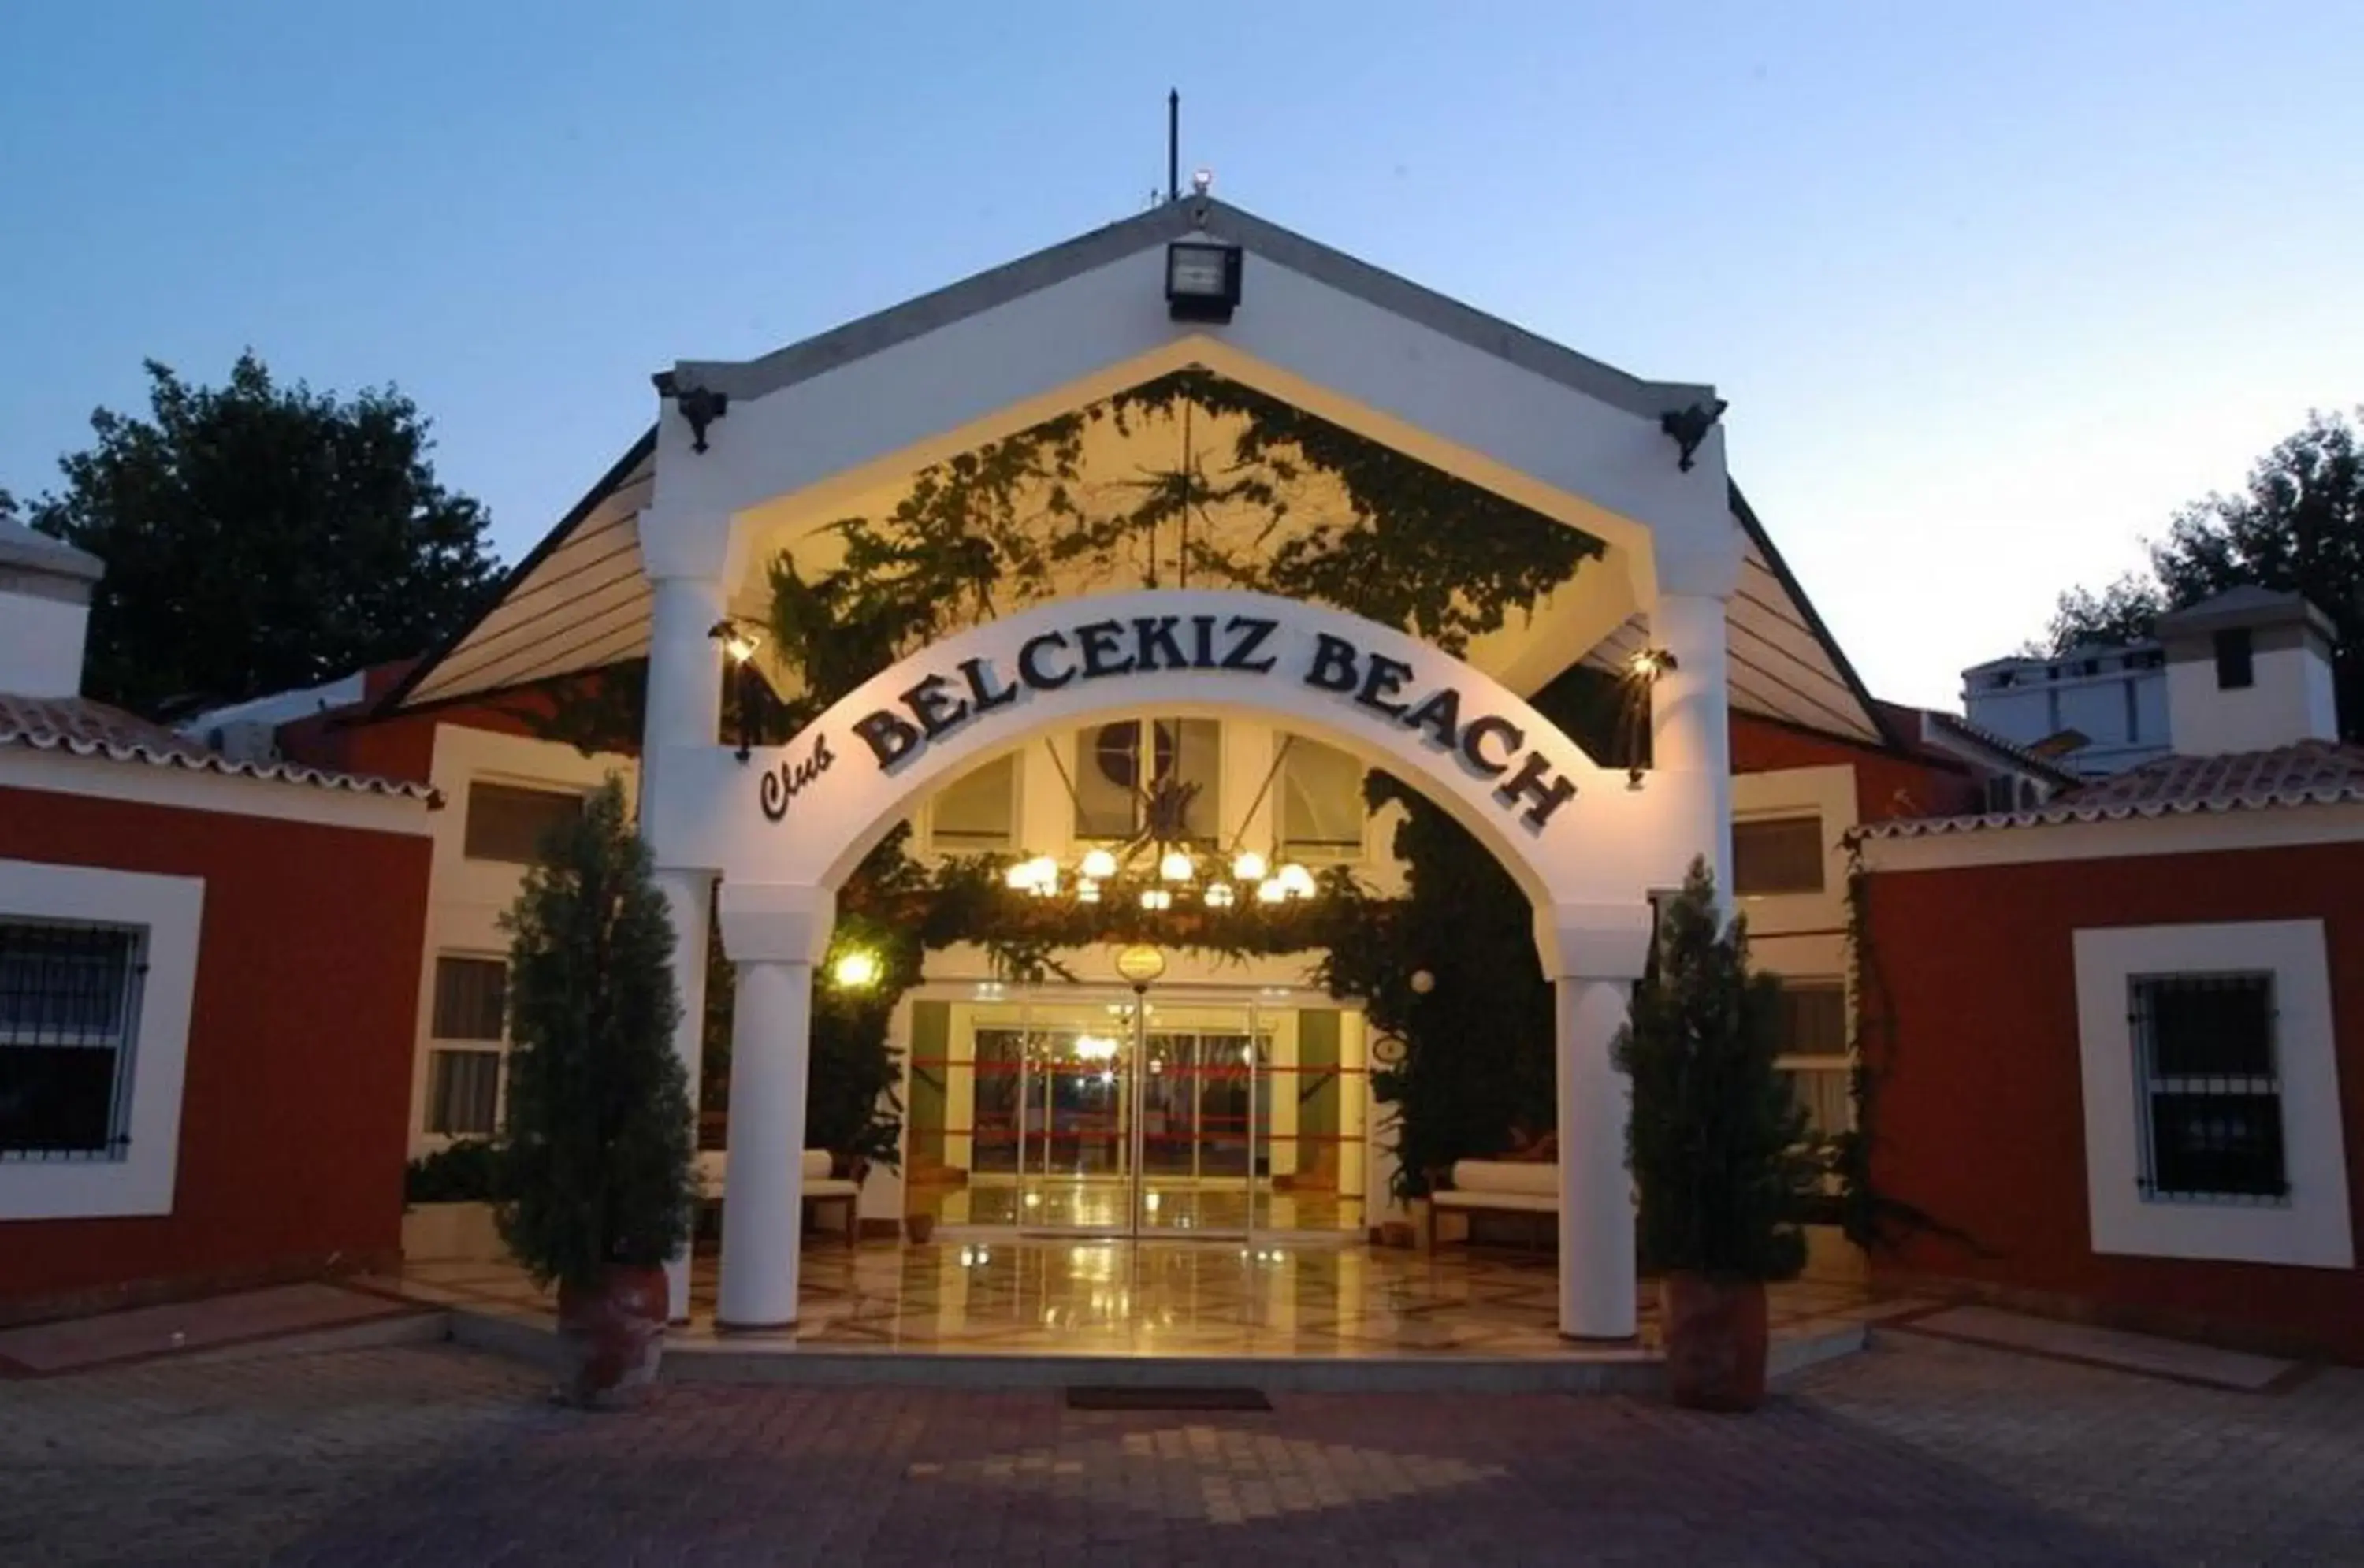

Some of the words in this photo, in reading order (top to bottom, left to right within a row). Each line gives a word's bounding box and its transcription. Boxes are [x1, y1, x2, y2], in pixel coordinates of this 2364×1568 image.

[760, 734, 835, 821] Club
[852, 615, 1280, 770] BELCEKIZ
[1304, 633, 1577, 827] BEACH
